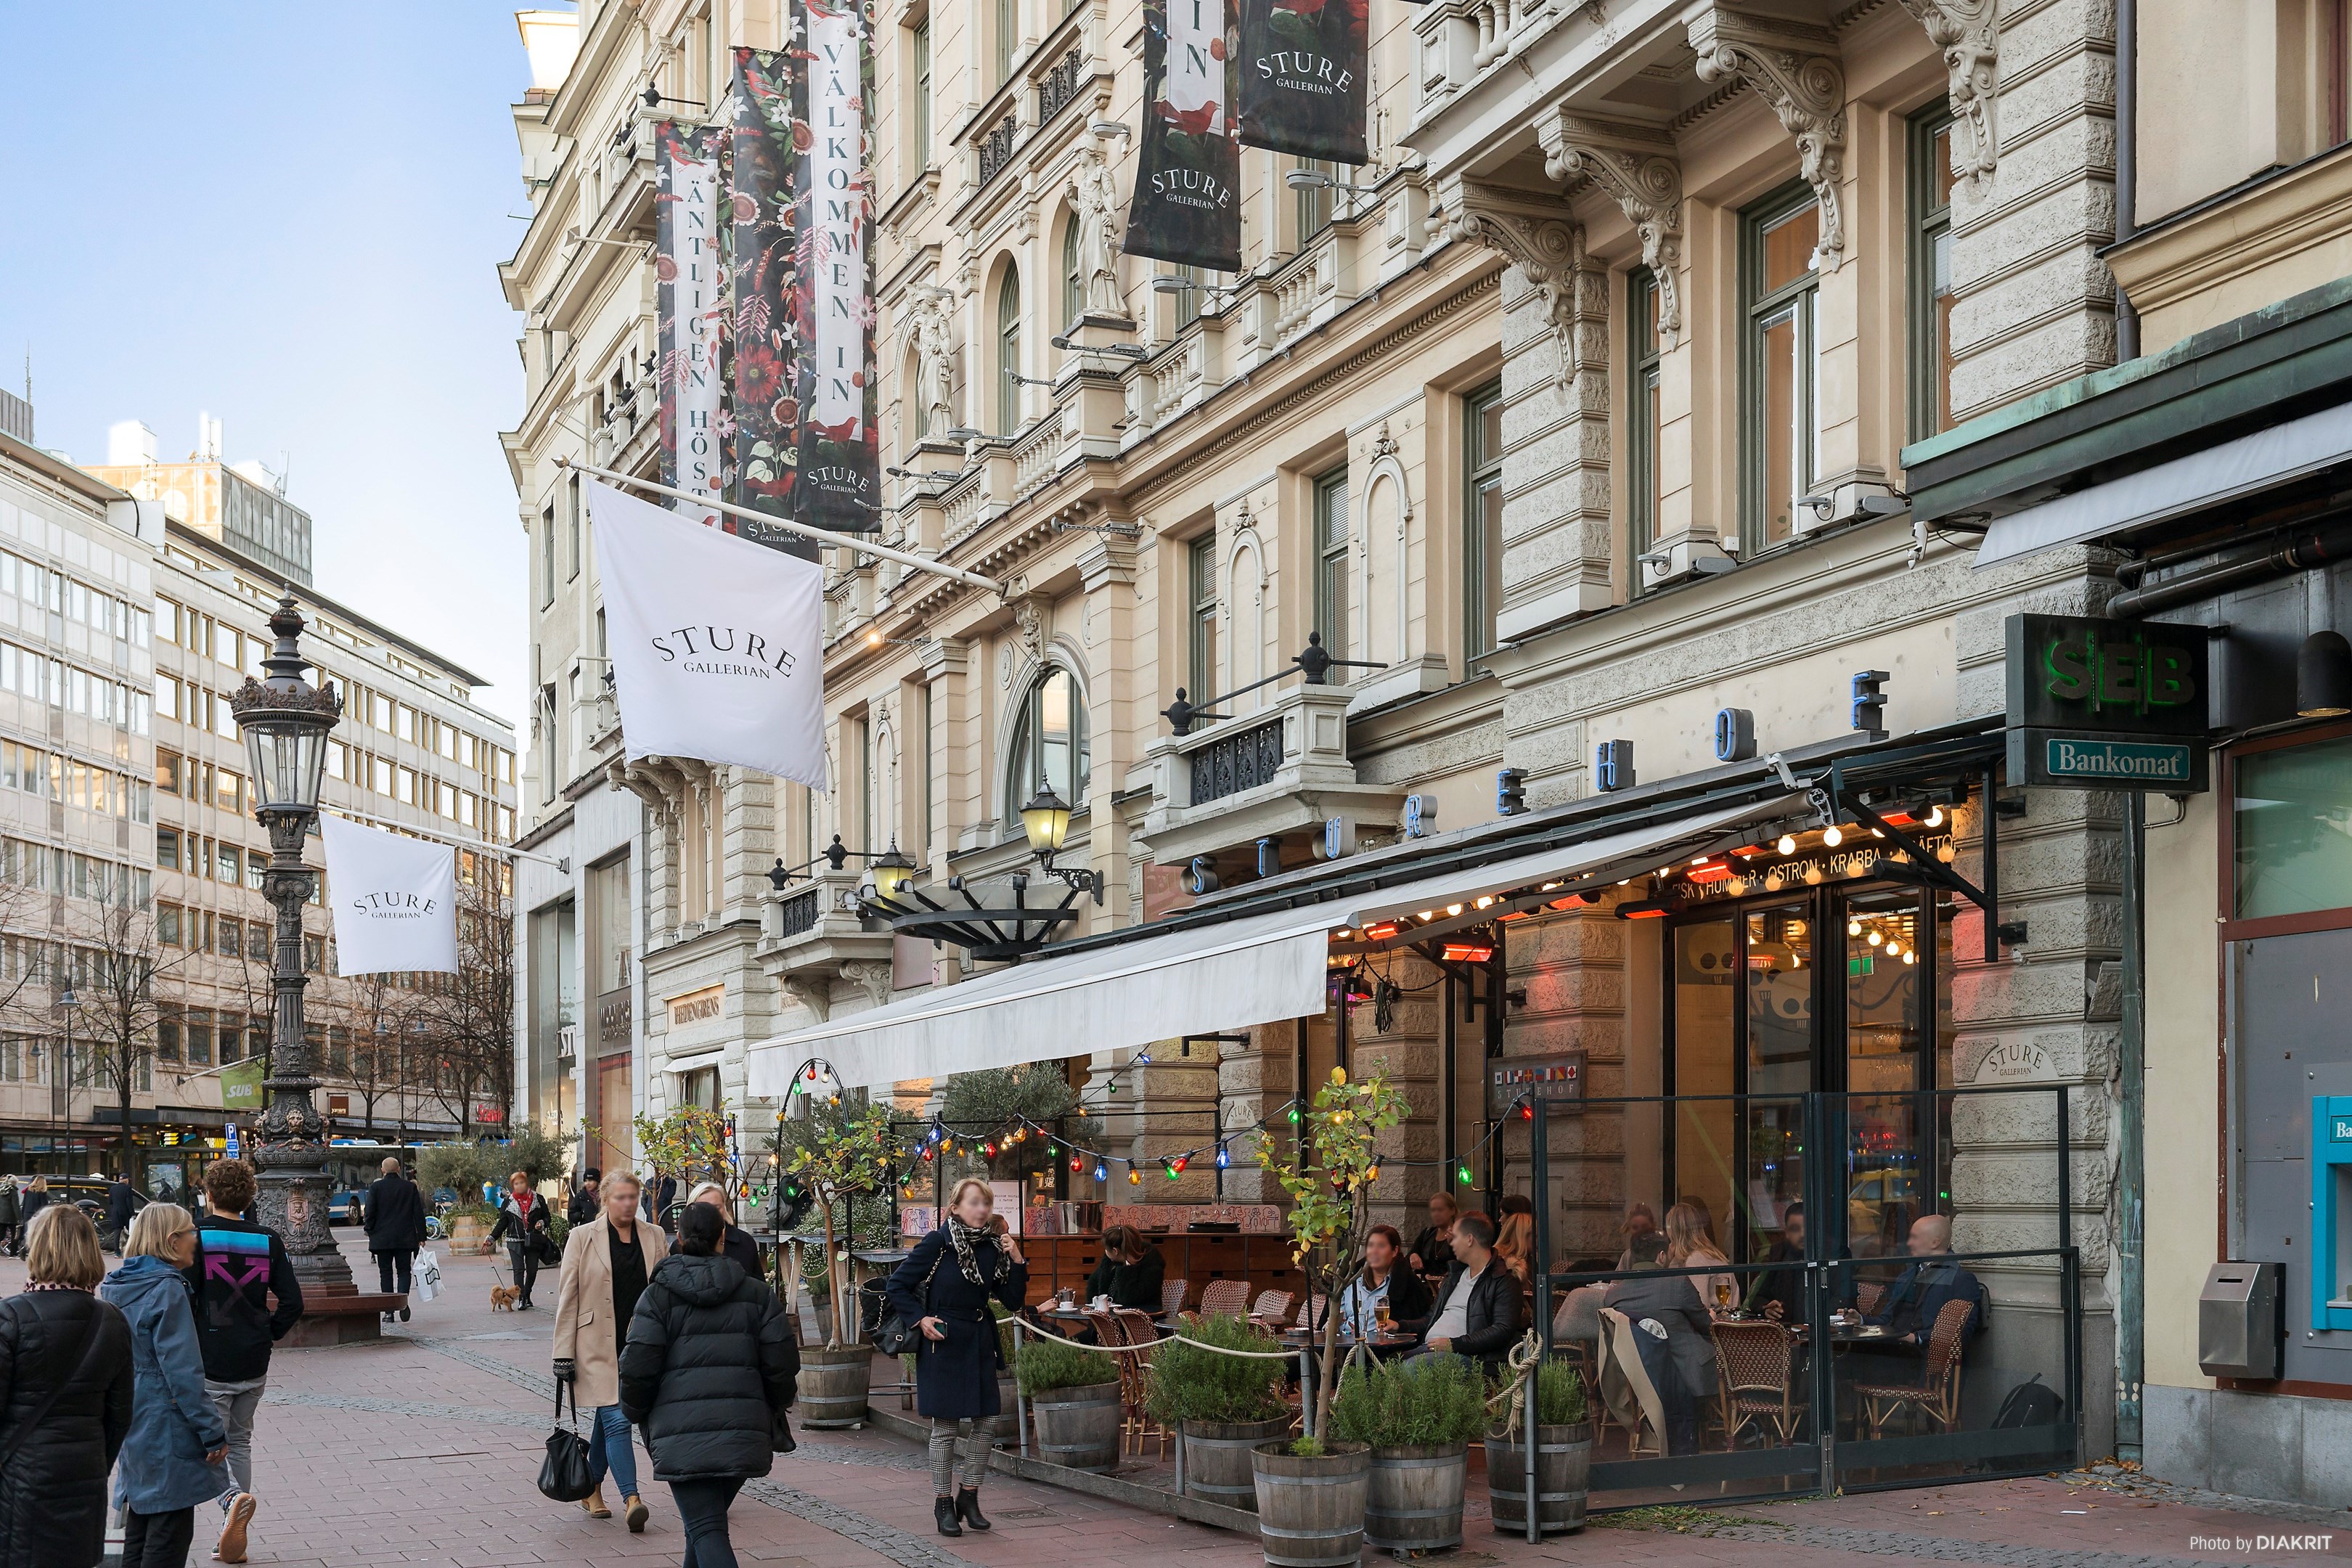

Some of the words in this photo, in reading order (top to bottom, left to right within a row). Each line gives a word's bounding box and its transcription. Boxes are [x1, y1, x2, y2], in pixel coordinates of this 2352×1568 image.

[1186, 0, 1207, 78] IN
[1256, 50, 1353, 93] STURE
[1276, 78, 1333, 95] GALLERIAN
[822, 44, 851, 317] VÄLKOMMEN
[1151, 168, 1231, 209] STURE
[1166, 192, 1214, 211] GALLERIAN
[687, 180, 706, 388] ÄNTLIGEN
[831, 346, 850, 401] IN
[690, 409, 709, 507] HÖST
[807, 465, 870, 493] STURE
[820, 483, 857, 494] GALLERIAN
[650, 625, 797, 679] STURE
[683, 661, 770, 679] GALLERIAN
[2047, 640, 2196, 704] SEB
[1768, 858, 1818, 883] OSTRON
[353, 891, 438, 916] STURE
[1988, 1044, 2043, 1072] STURE
[1999, 1067, 2032, 1076] GALLERIAN
[1230, 1105, 1251, 1122] STURE
[228, 1125, 234, 1139] P
